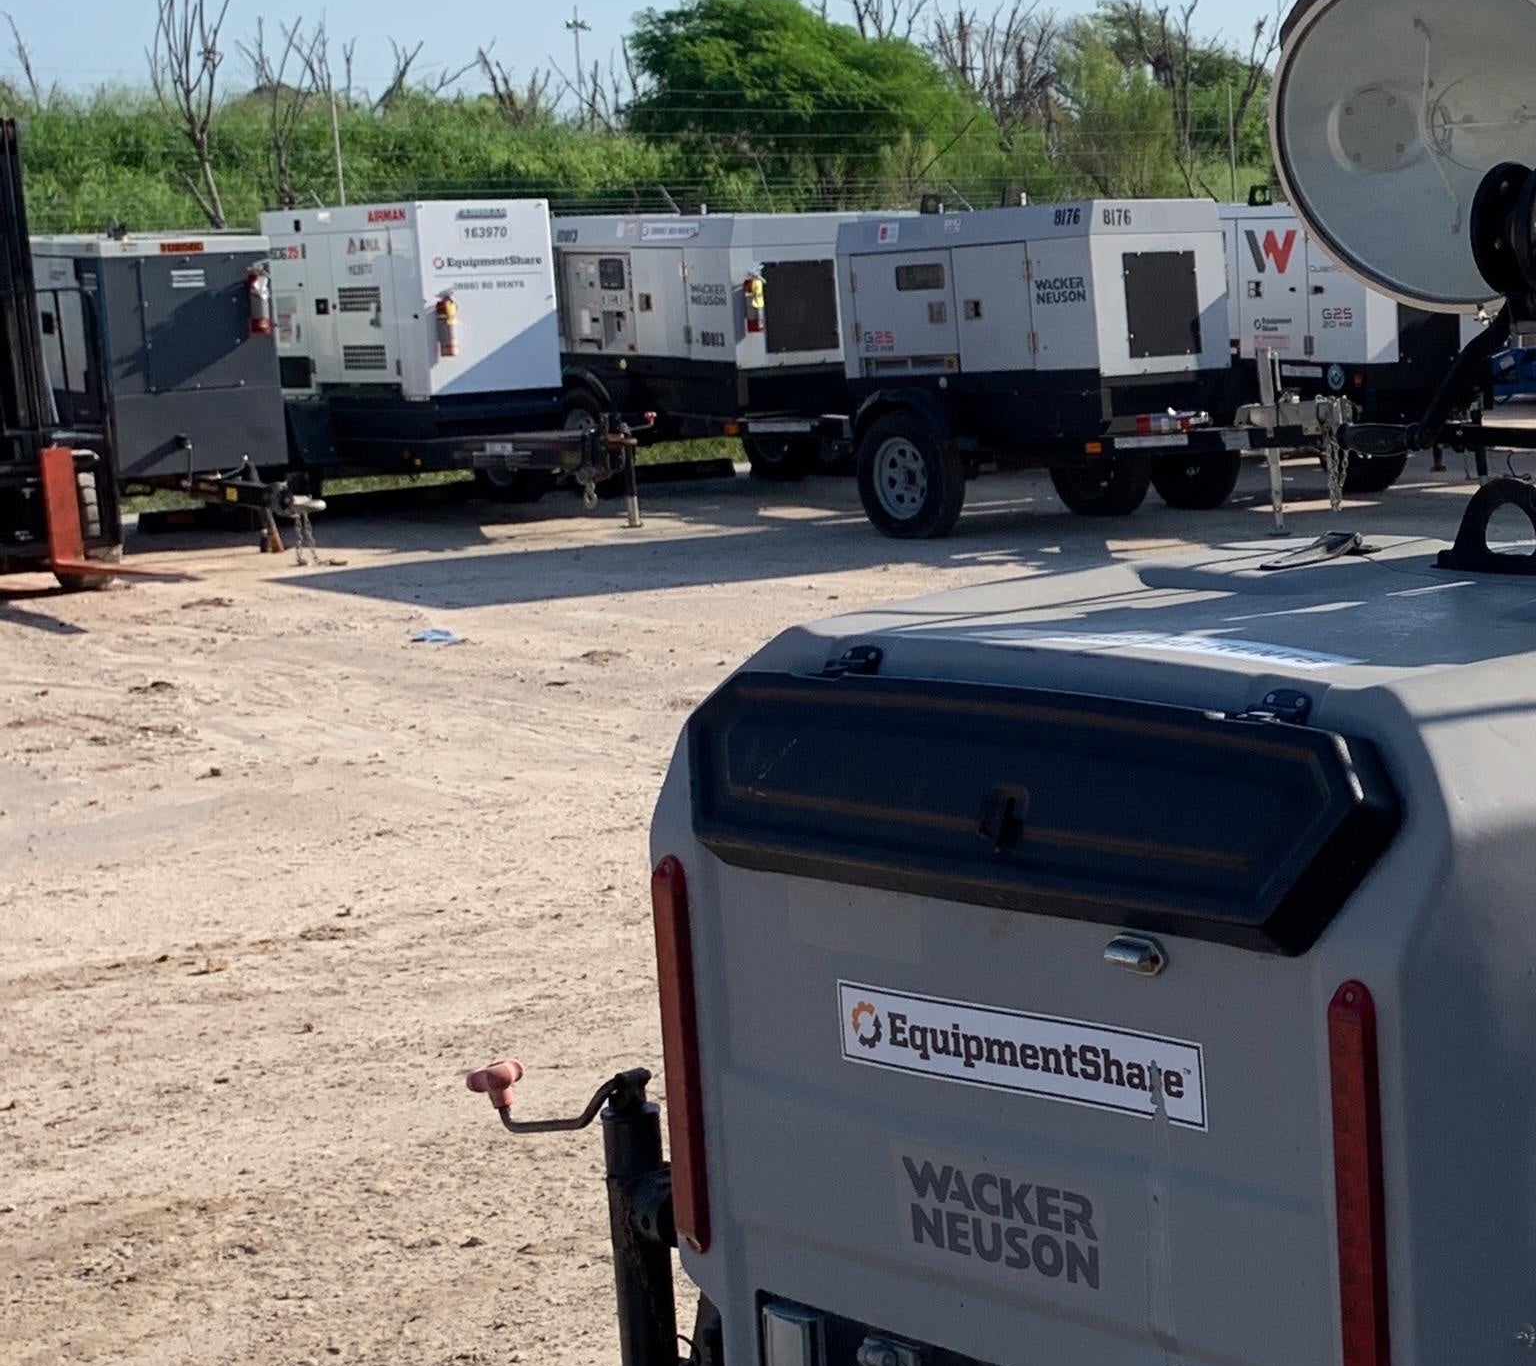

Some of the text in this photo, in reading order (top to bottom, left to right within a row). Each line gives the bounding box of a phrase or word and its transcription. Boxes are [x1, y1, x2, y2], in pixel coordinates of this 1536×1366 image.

[367, 209, 407, 224] AIRMAN
[1102, 208, 1133, 227] 8176
[464, 225, 509, 240] 163970
[446, 254, 543, 271] EquipmentShare
[690, 283, 727, 295] WACKER
[1034, 276, 1085, 291] WACKER
[690, 294, 728, 307] NEUSON
[1036, 290, 1088, 305] NEUSON
[1321, 307, 1354, 320] G25
[863, 330, 895, 345] G25
[887, 1011, 1186, 1099] EquipmentShare
[901, 1155, 1099, 1242] WACKER
[910, 1202, 1101, 1290] NEUSON
